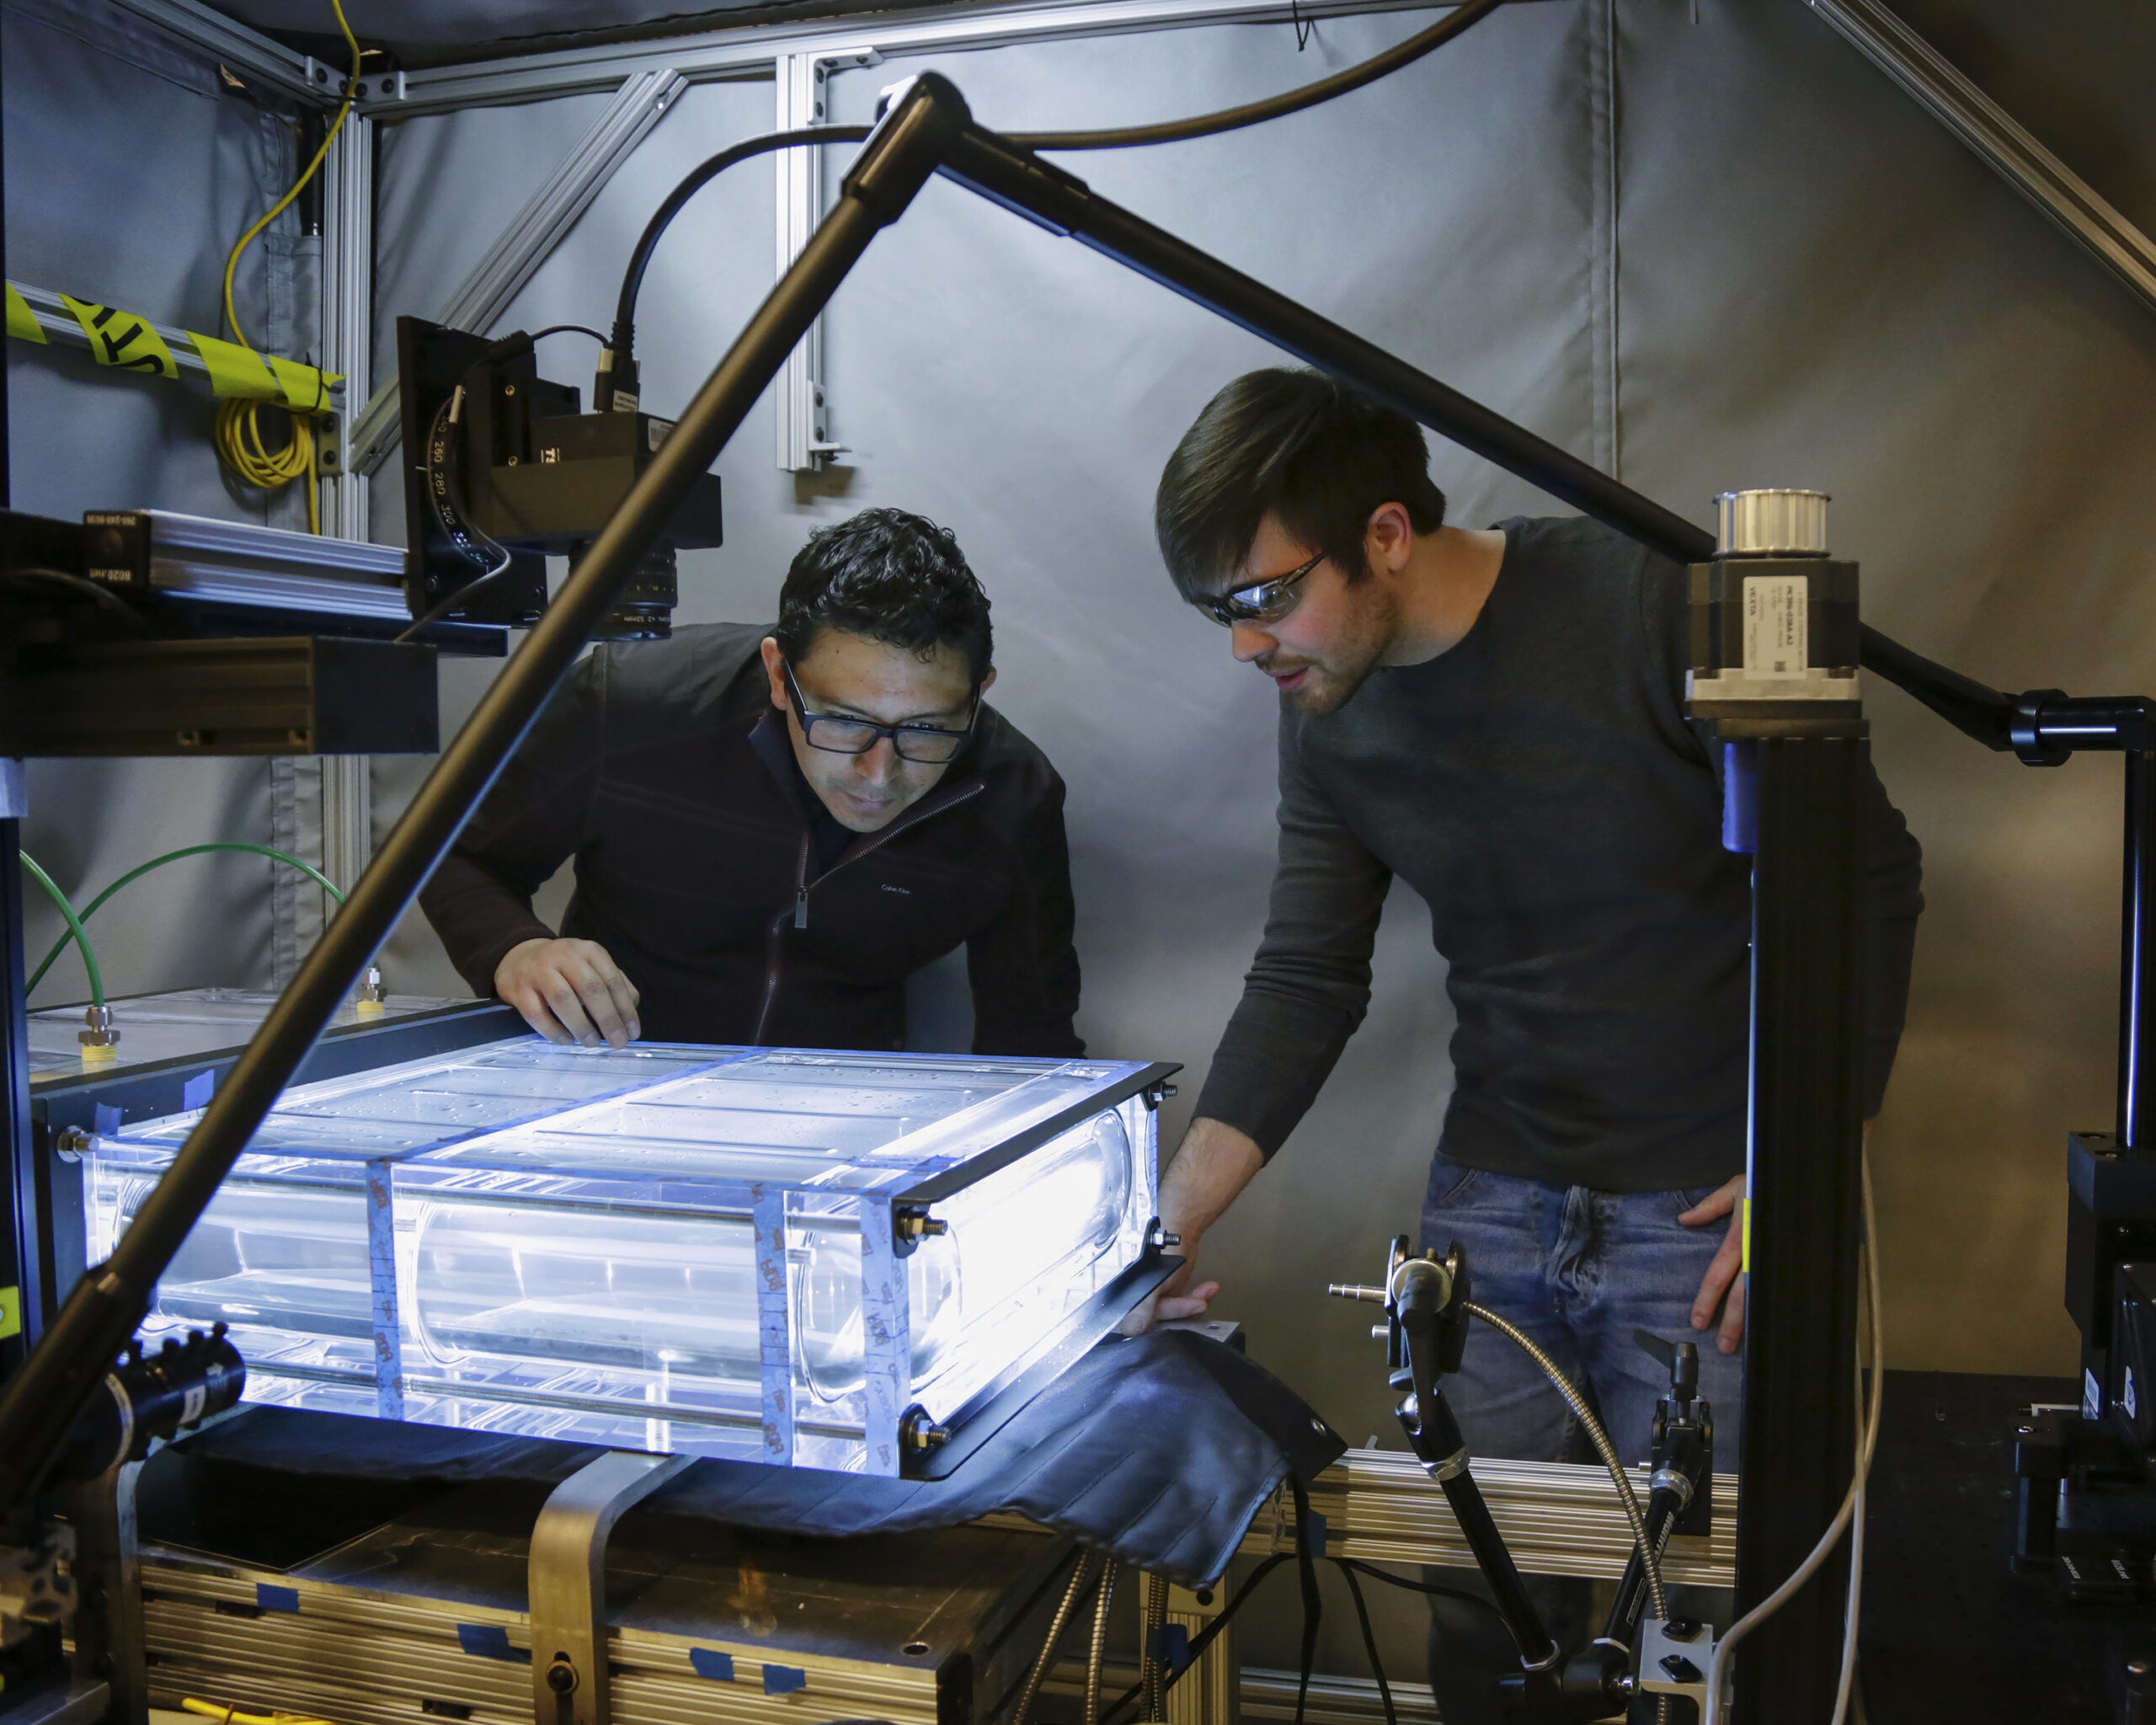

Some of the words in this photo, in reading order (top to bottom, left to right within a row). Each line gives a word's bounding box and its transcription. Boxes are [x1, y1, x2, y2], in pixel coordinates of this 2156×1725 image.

[434, 441, 445, 463] 260
[435, 473, 446, 495] 280
[440, 504, 456, 525] 300
